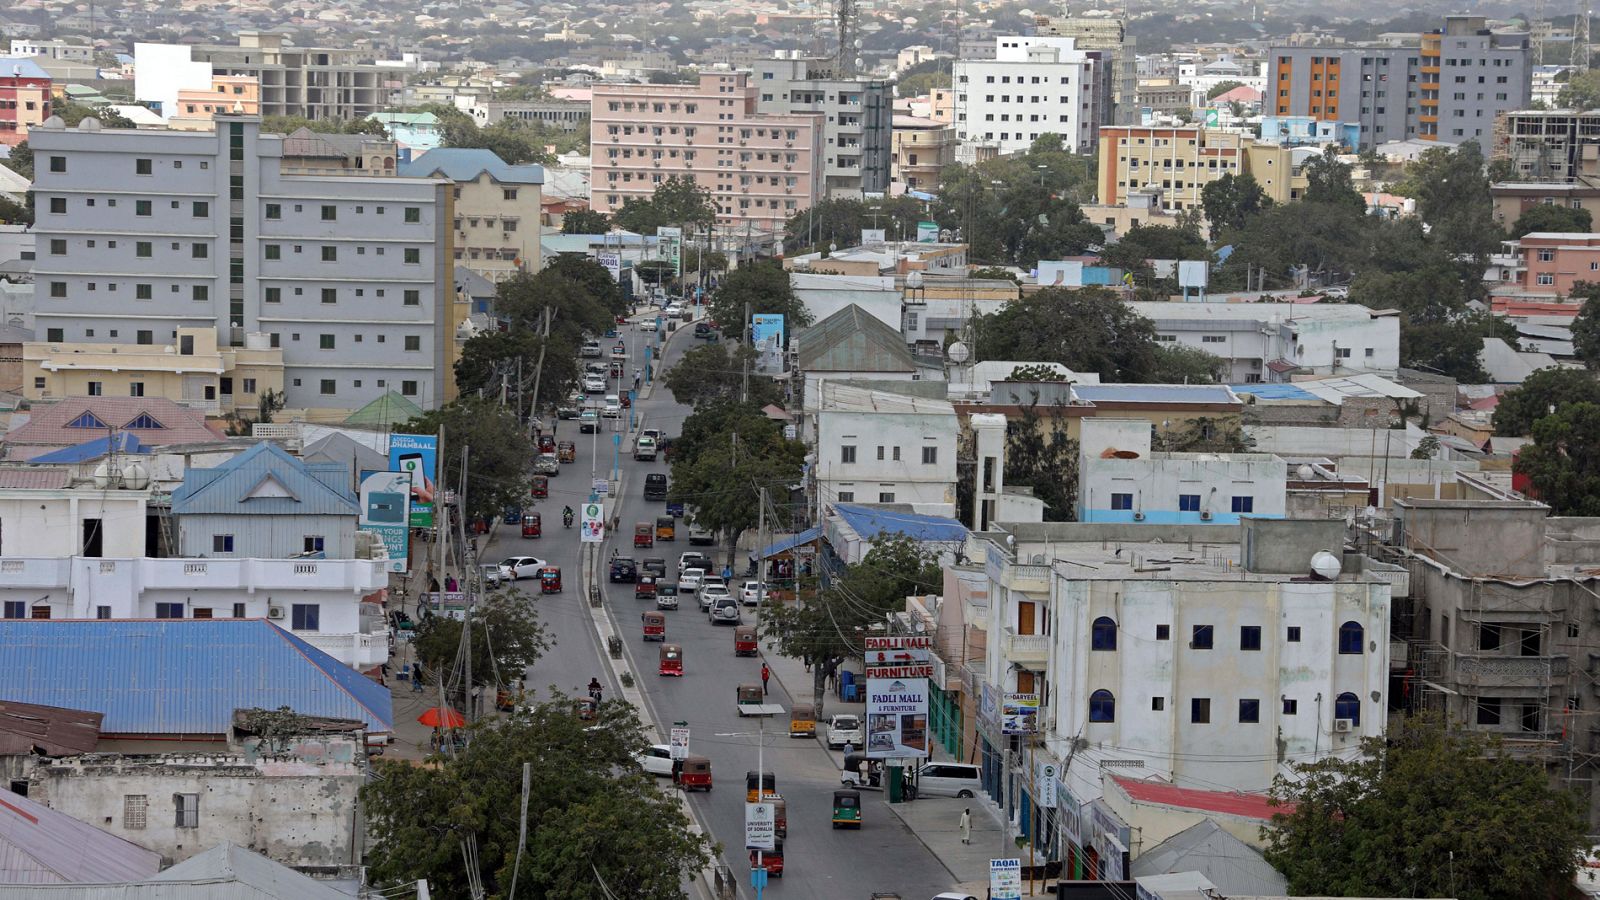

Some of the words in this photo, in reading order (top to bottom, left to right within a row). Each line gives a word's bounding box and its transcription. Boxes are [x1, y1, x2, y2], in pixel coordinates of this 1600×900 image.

[392, 441, 432, 449] DHAMBAAL
[865, 638, 898, 648] FADLI
[901, 637, 932, 649] MALL
[866, 666, 934, 678] FURNITURE
[872, 694, 897, 703] FADLI
[899, 694, 923, 703] MALL
